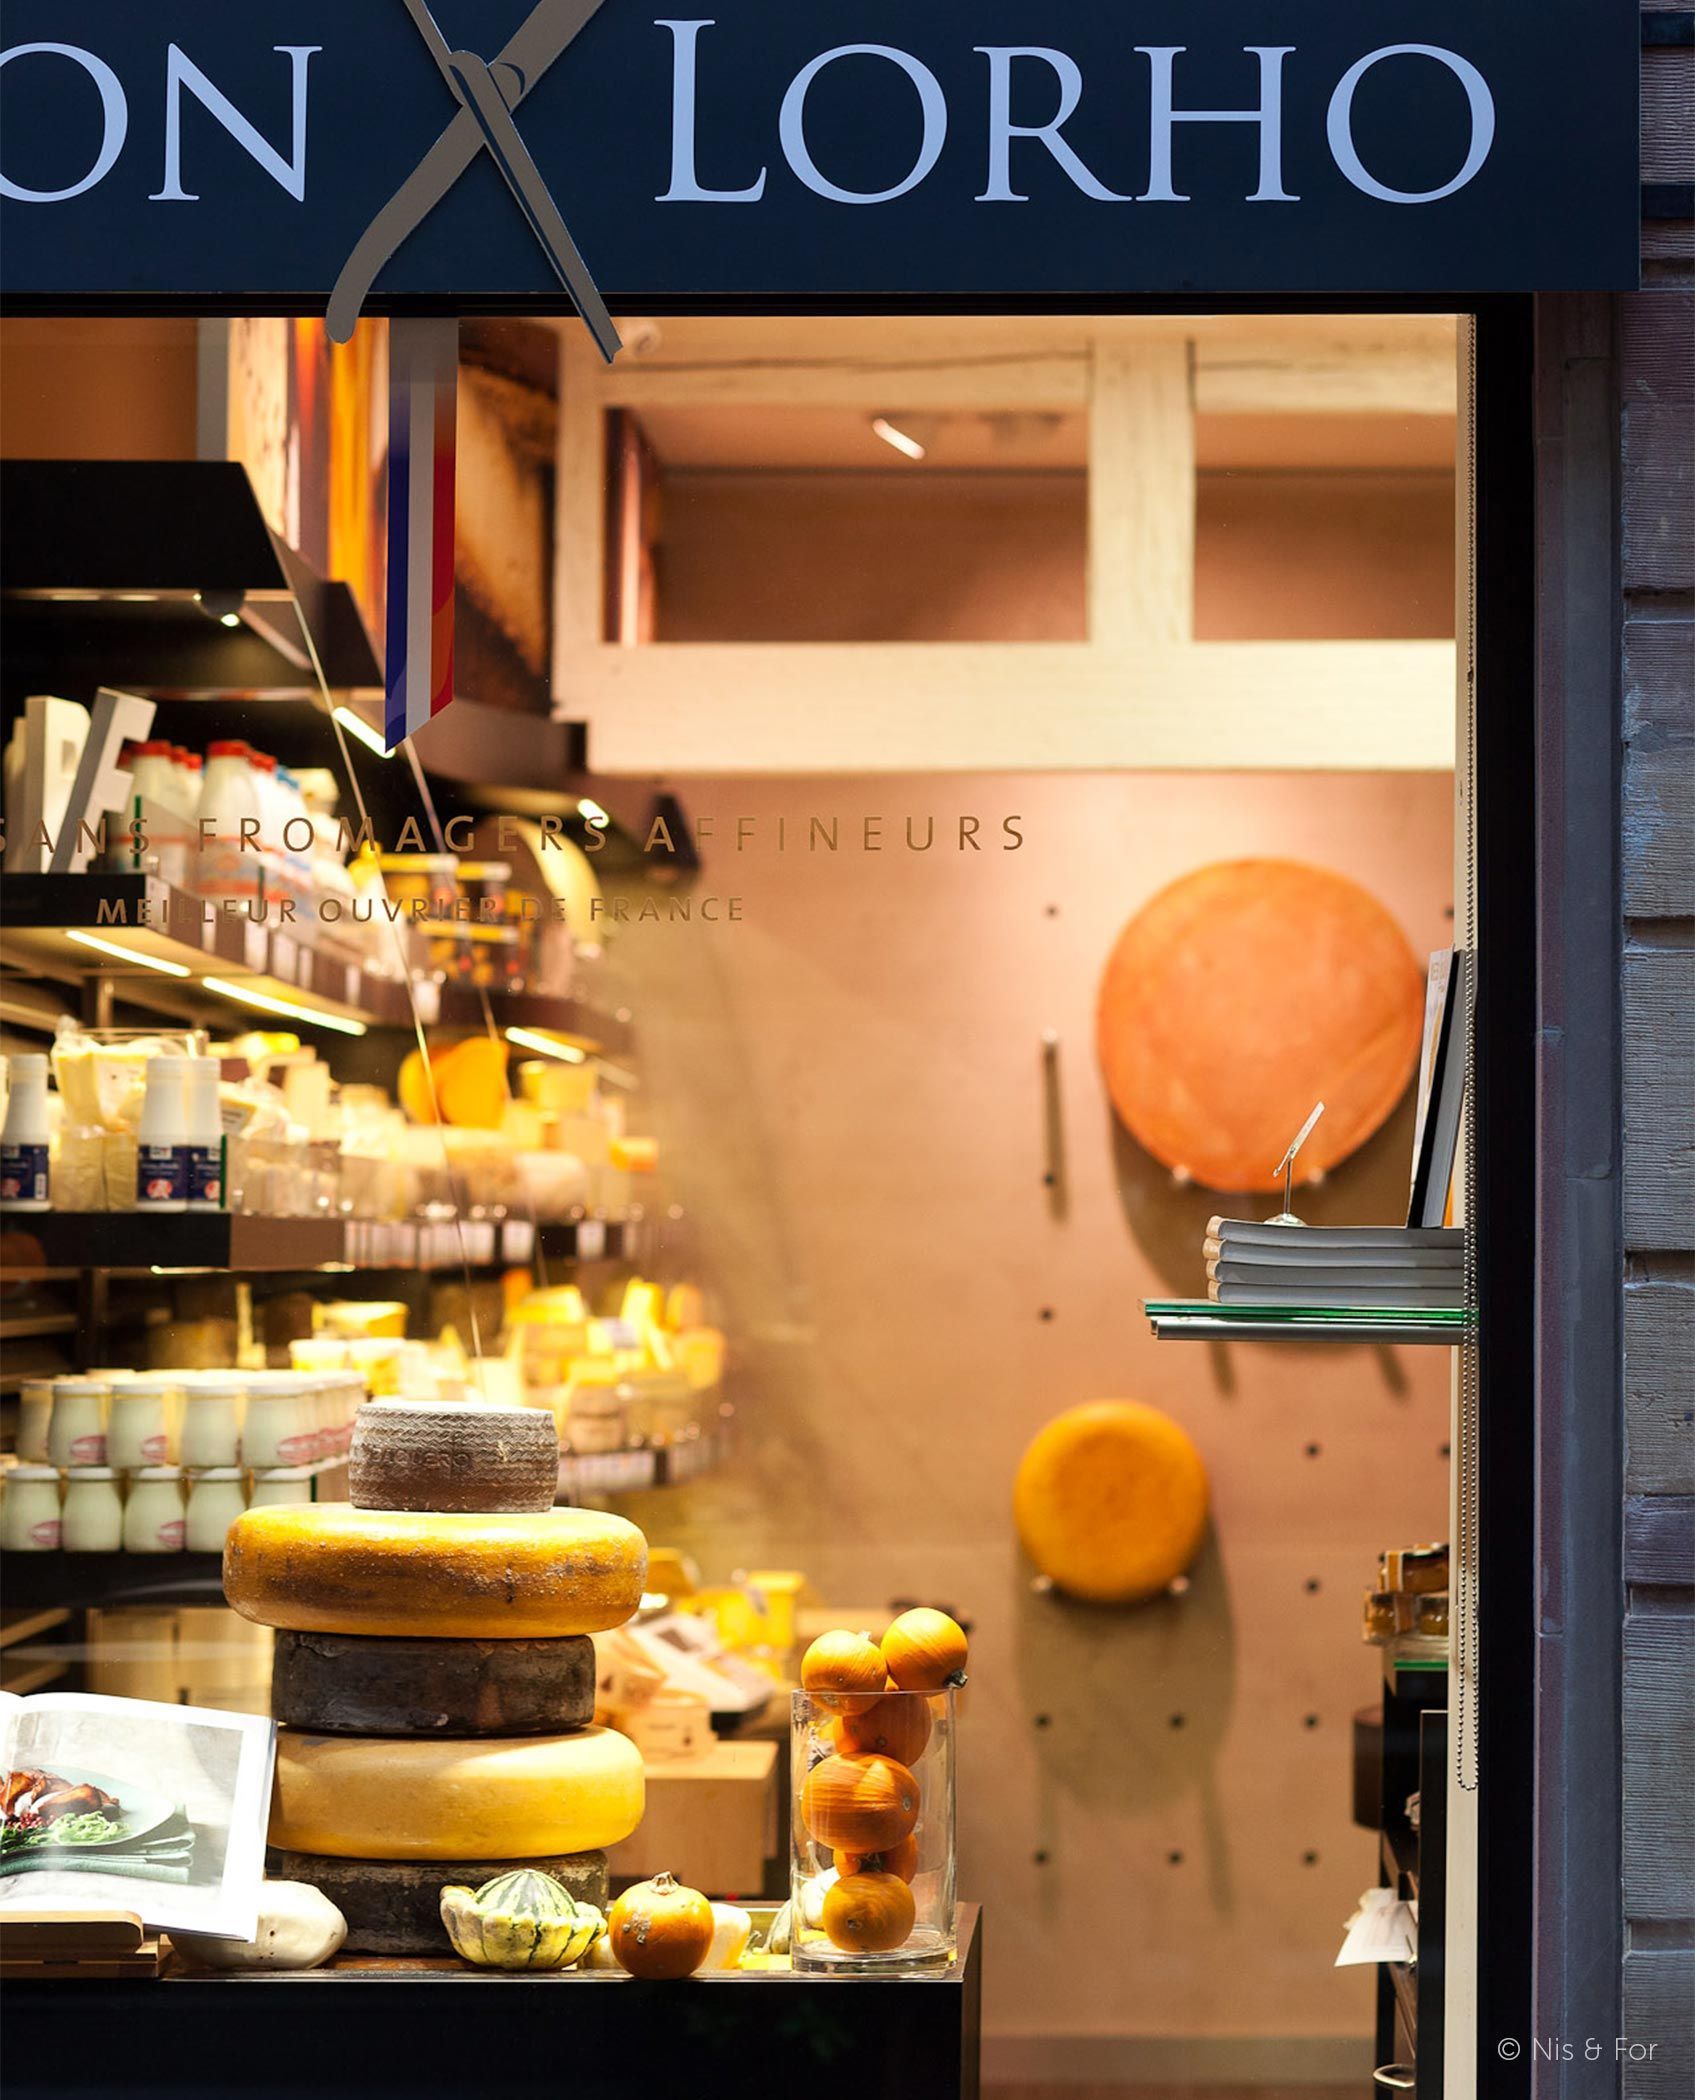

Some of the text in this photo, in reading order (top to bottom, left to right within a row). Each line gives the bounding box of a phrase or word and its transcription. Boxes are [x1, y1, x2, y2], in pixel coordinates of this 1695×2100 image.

[0, 19, 1495, 204] ON LORHO
[199, 816, 608, 853] FROMAGERS
[643, 815, 1024, 852] AFFINEURS
[96, 897, 743, 925] MEILLEUR OUVRIER DE FRANCE
